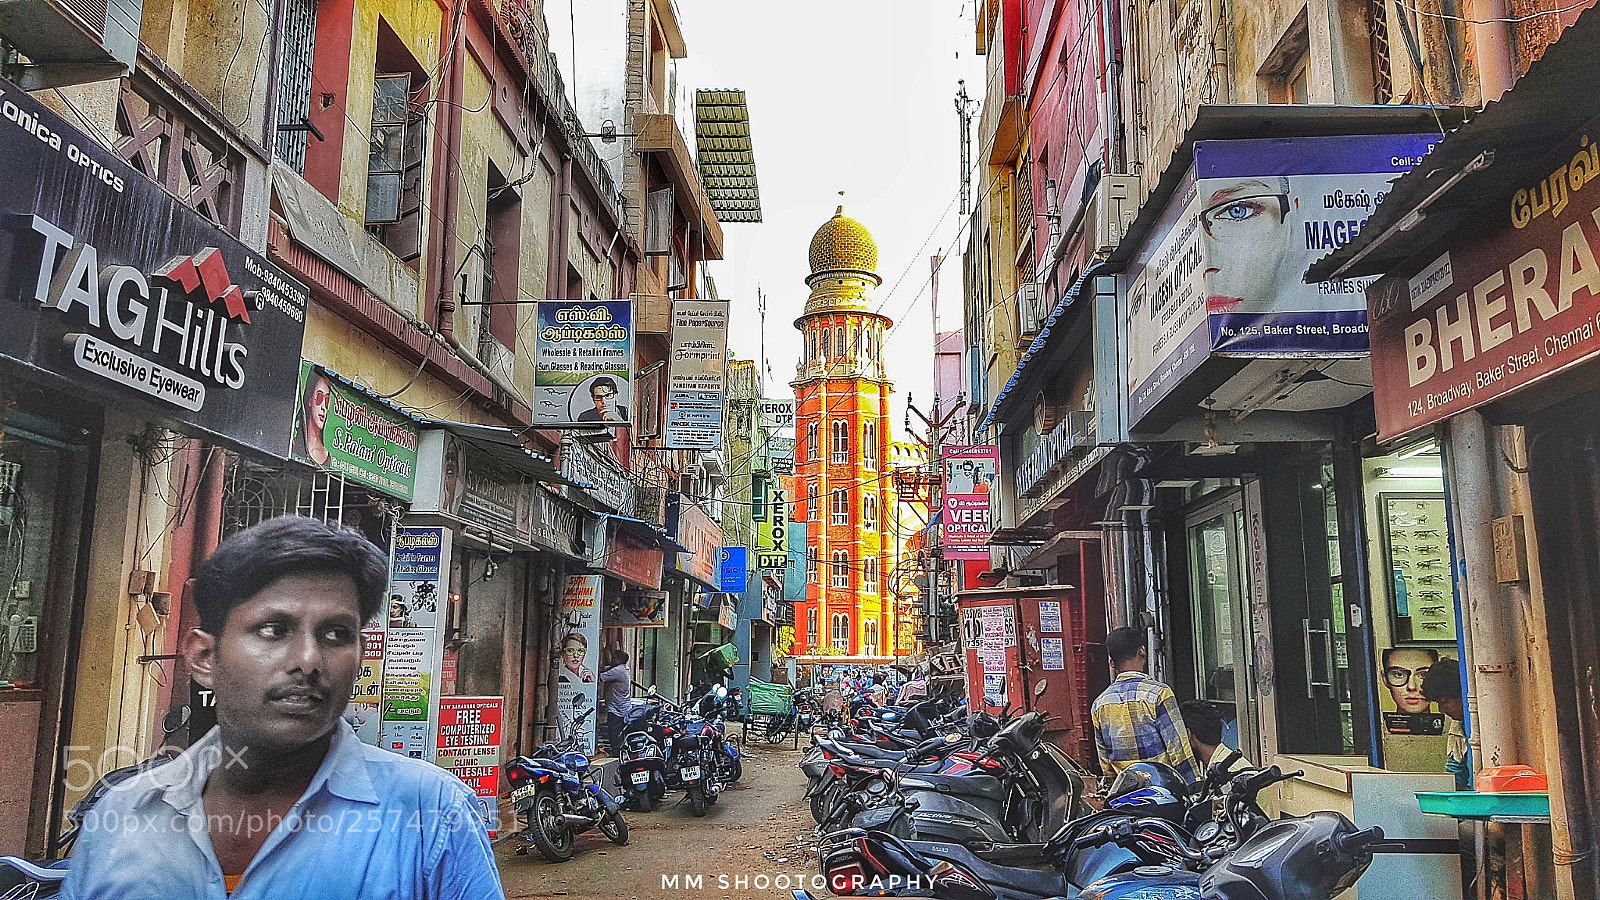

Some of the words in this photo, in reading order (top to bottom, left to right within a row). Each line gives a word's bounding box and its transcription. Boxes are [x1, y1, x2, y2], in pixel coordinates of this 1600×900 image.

[0, 89, 62, 152] onica
[67, 144, 124, 193] OPTICS
[1323, 189, 1371, 212] மகேஷ்
[1174, 237, 1203, 292] OPTICAL
[1318, 280, 1355, 295] FRAMES
[1405, 206, 1600, 388] BHERA
[1221, 326, 1238, 337] No.
[1240, 326, 1261, 337] 125,
[1264, 325, 1293, 336] Baker
[1295, 324, 1330, 336] Street,
[82, 341, 147, 382] Exclusive
[148, 368, 201, 404] Eyewear
[1407, 398, 1427, 418] 124,
[1427, 379, 1475, 410] Broadway,
[1475, 363, 1505, 389] Baker
[1507, 345, 1543, 374] Street,
[1544, 316, 1594, 357] Chennai
[760, 403, 793, 414] XEROX
[775, 414, 793, 423] DTP
[376, 447, 412, 479] Opticals
[771, 490, 785, 552] XEROX
[760, 556, 787, 568] DTP
[456, 709, 482, 725] FREE
[440, 723, 496, 736] COMPUTERIZED
[445, 735, 459, 747] EYE
[460, 734, 490, 746] TESTING
[437, 748, 472, 758] CONTACT
[473, 747, 496, 756] LENSE
[454, 758, 479, 767] CLINIC
